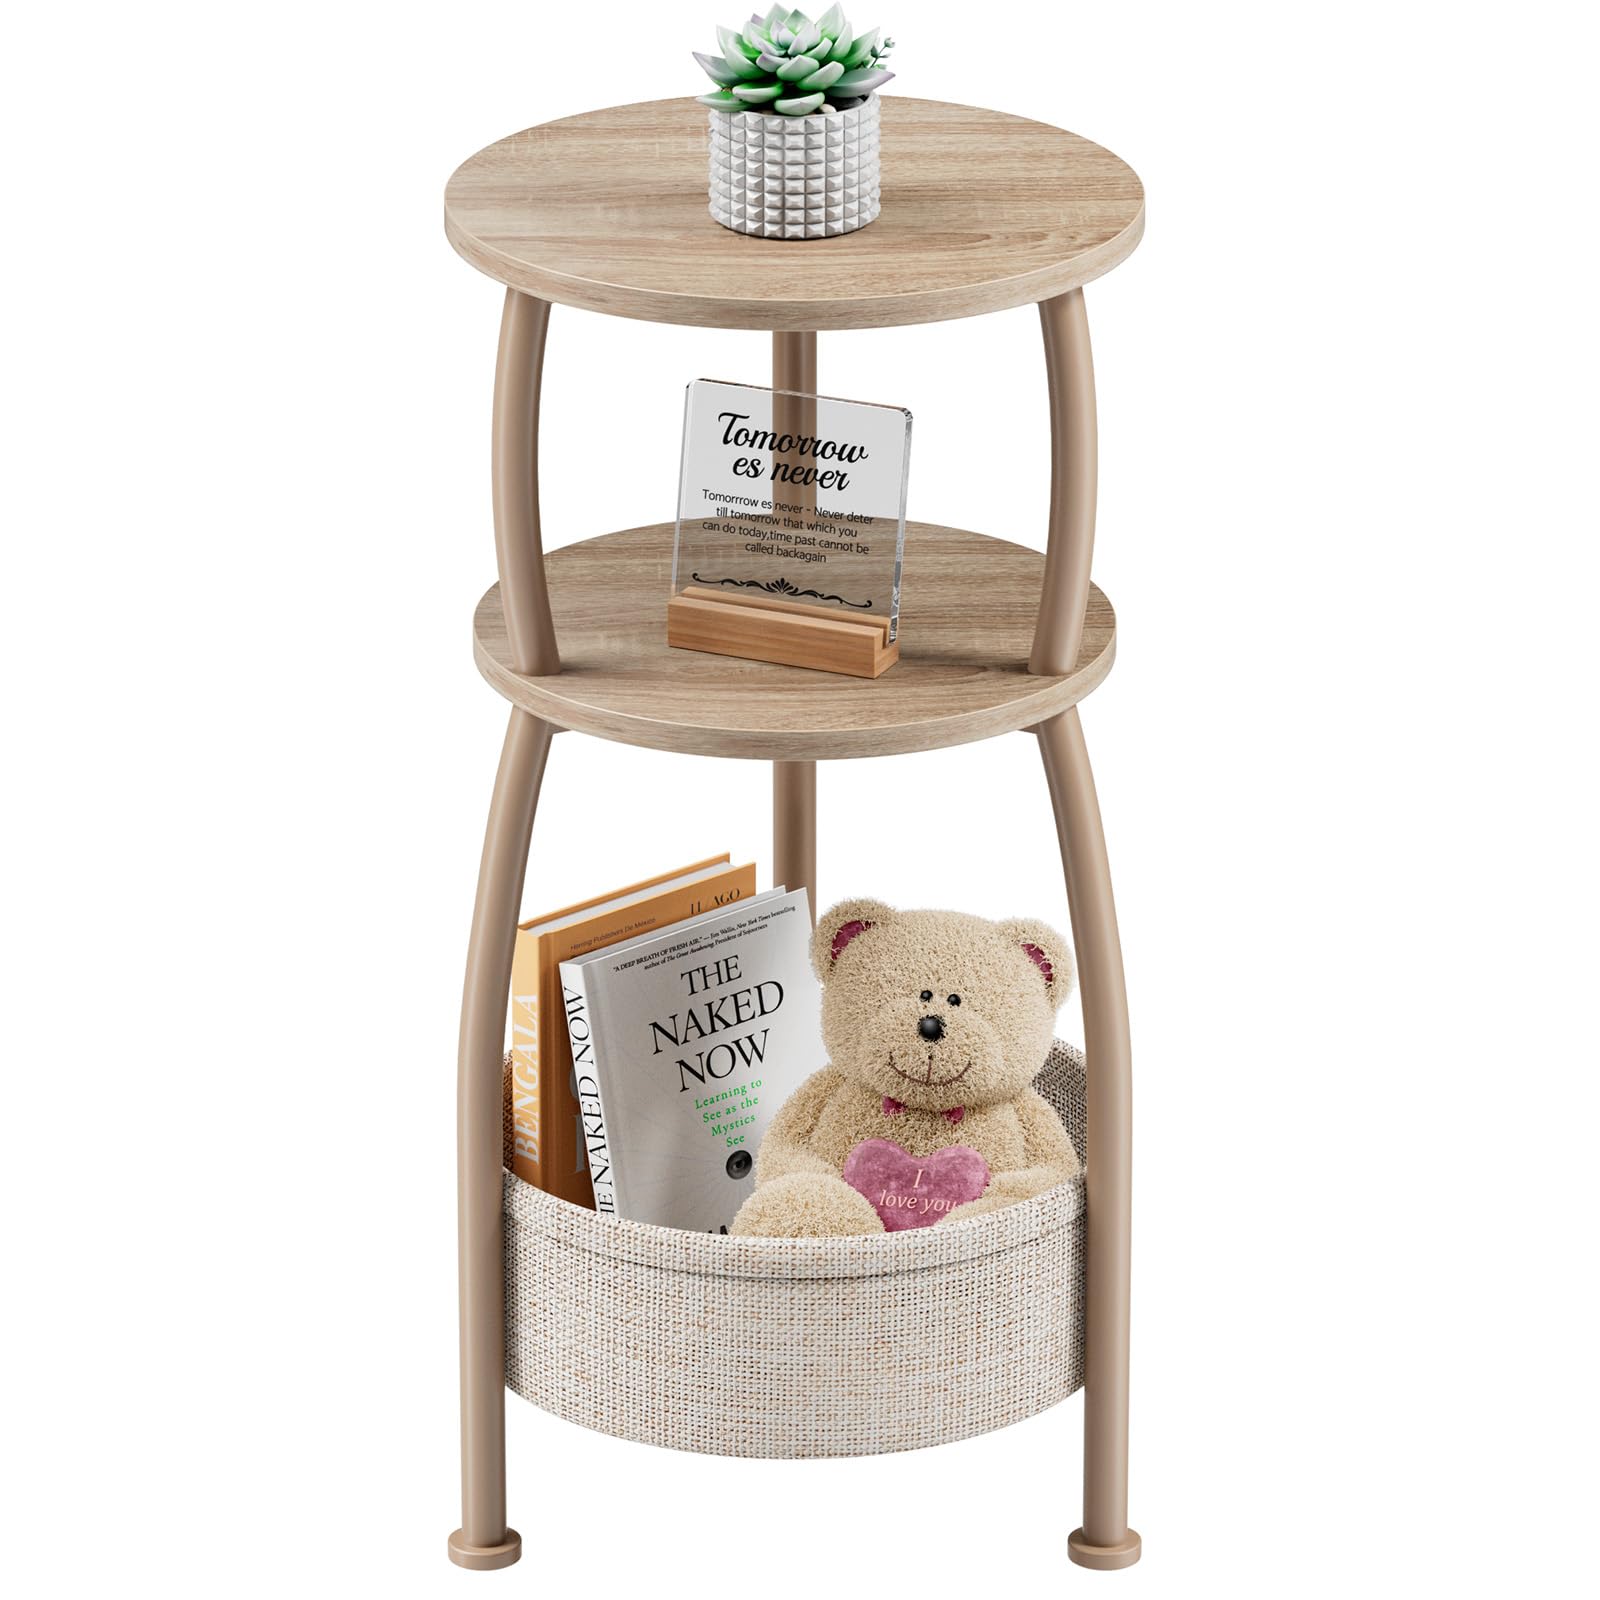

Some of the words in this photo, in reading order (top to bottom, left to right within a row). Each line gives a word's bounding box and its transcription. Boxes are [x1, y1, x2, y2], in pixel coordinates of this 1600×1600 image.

[718, 412, 869, 464] Tomorrow
[732, 457, 765, 479] es
[770, 462, 850, 491] never
[716, 507, 728, 518] till
[730, 509, 781, 526] tomorrow
[783, 516, 804, 530] that
[806, 521, 836, 535] which
[838, 527, 858, 538] you
[761, 500, 773, 509] es
[774, 502, 804, 514] never
[814, 506, 844, 520] Never
[846, 512, 874, 525] deter
[702, 521, 720, 531] can
[722, 523, 736, 534] do
[794, 535, 817, 546] past
[819, 539, 854, 552] cannot
[856, 543, 870, 554] be
[745, 542, 774, 555] called
[776, 545, 827, 563] backagain
[620, 961, 636, 971] DEEP
[636, 952, 660, 966] BREATH
[660, 947, 669, 957] OF
[668, 943, 689, 955] FRESH
[680, 955, 742, 996] THE
[564, 987, 594, 1065] NOW
[648, 981, 784, 1055] NAKED
[675, 1028, 770, 1093] NOW
[514, 994, 540, 1165] BENGALA
[695, 1085, 747, 1110] Learning
[751, 1079, 762, 1089] to
[703, 1111, 722, 1123] See
[725, 1105, 737, 1115] as
[741, 1097, 759, 1109] the
[711, 1114, 756, 1137] Mystics
[578, 1075, 613, 1187] NAKED
[726, 1135, 745, 1148] See
[913, 1168, 925, 1189] I
[879, 1189, 918, 1209] love
